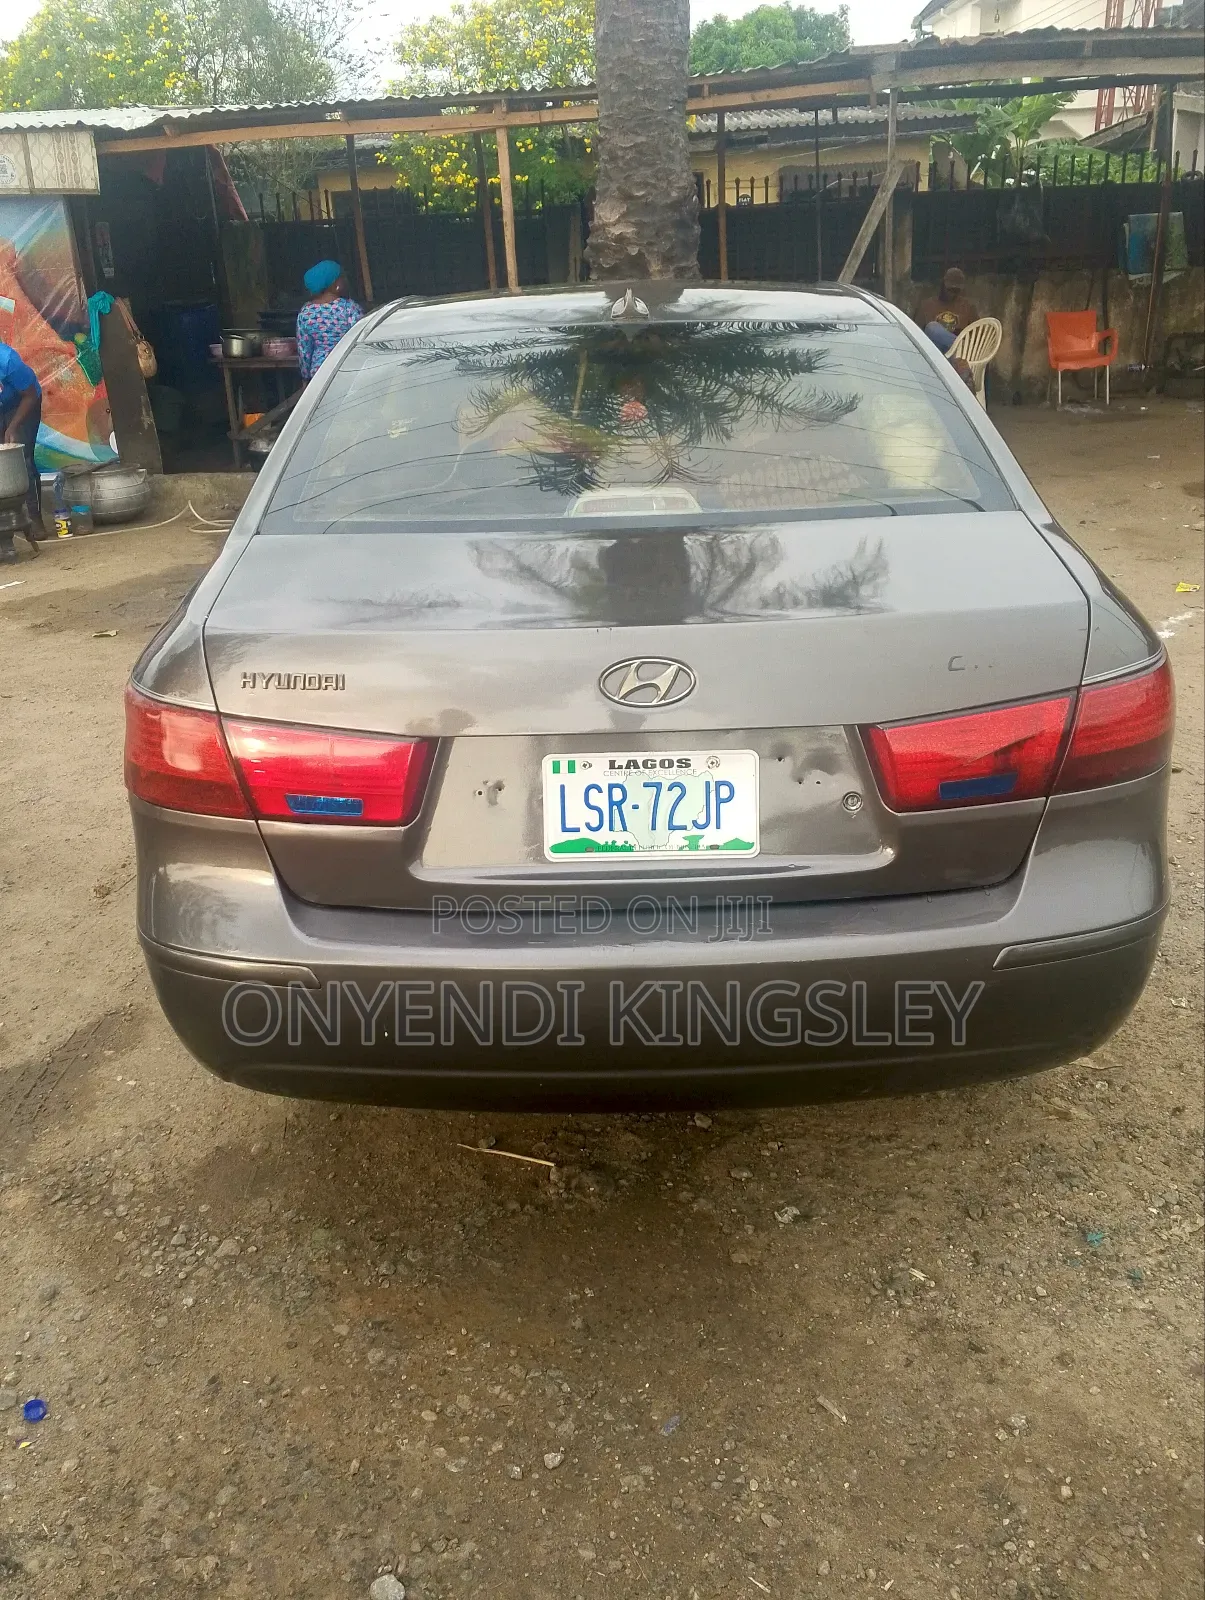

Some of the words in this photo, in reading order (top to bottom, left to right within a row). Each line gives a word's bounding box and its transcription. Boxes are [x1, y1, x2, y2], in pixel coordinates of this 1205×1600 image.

[240, 671, 346, 691] HYUNDAI
[608, 757, 692, 770] LAGOS
[648, 768, 698, 777] EXCELLENCE
[559, 780, 735, 833] LSR-72JP
